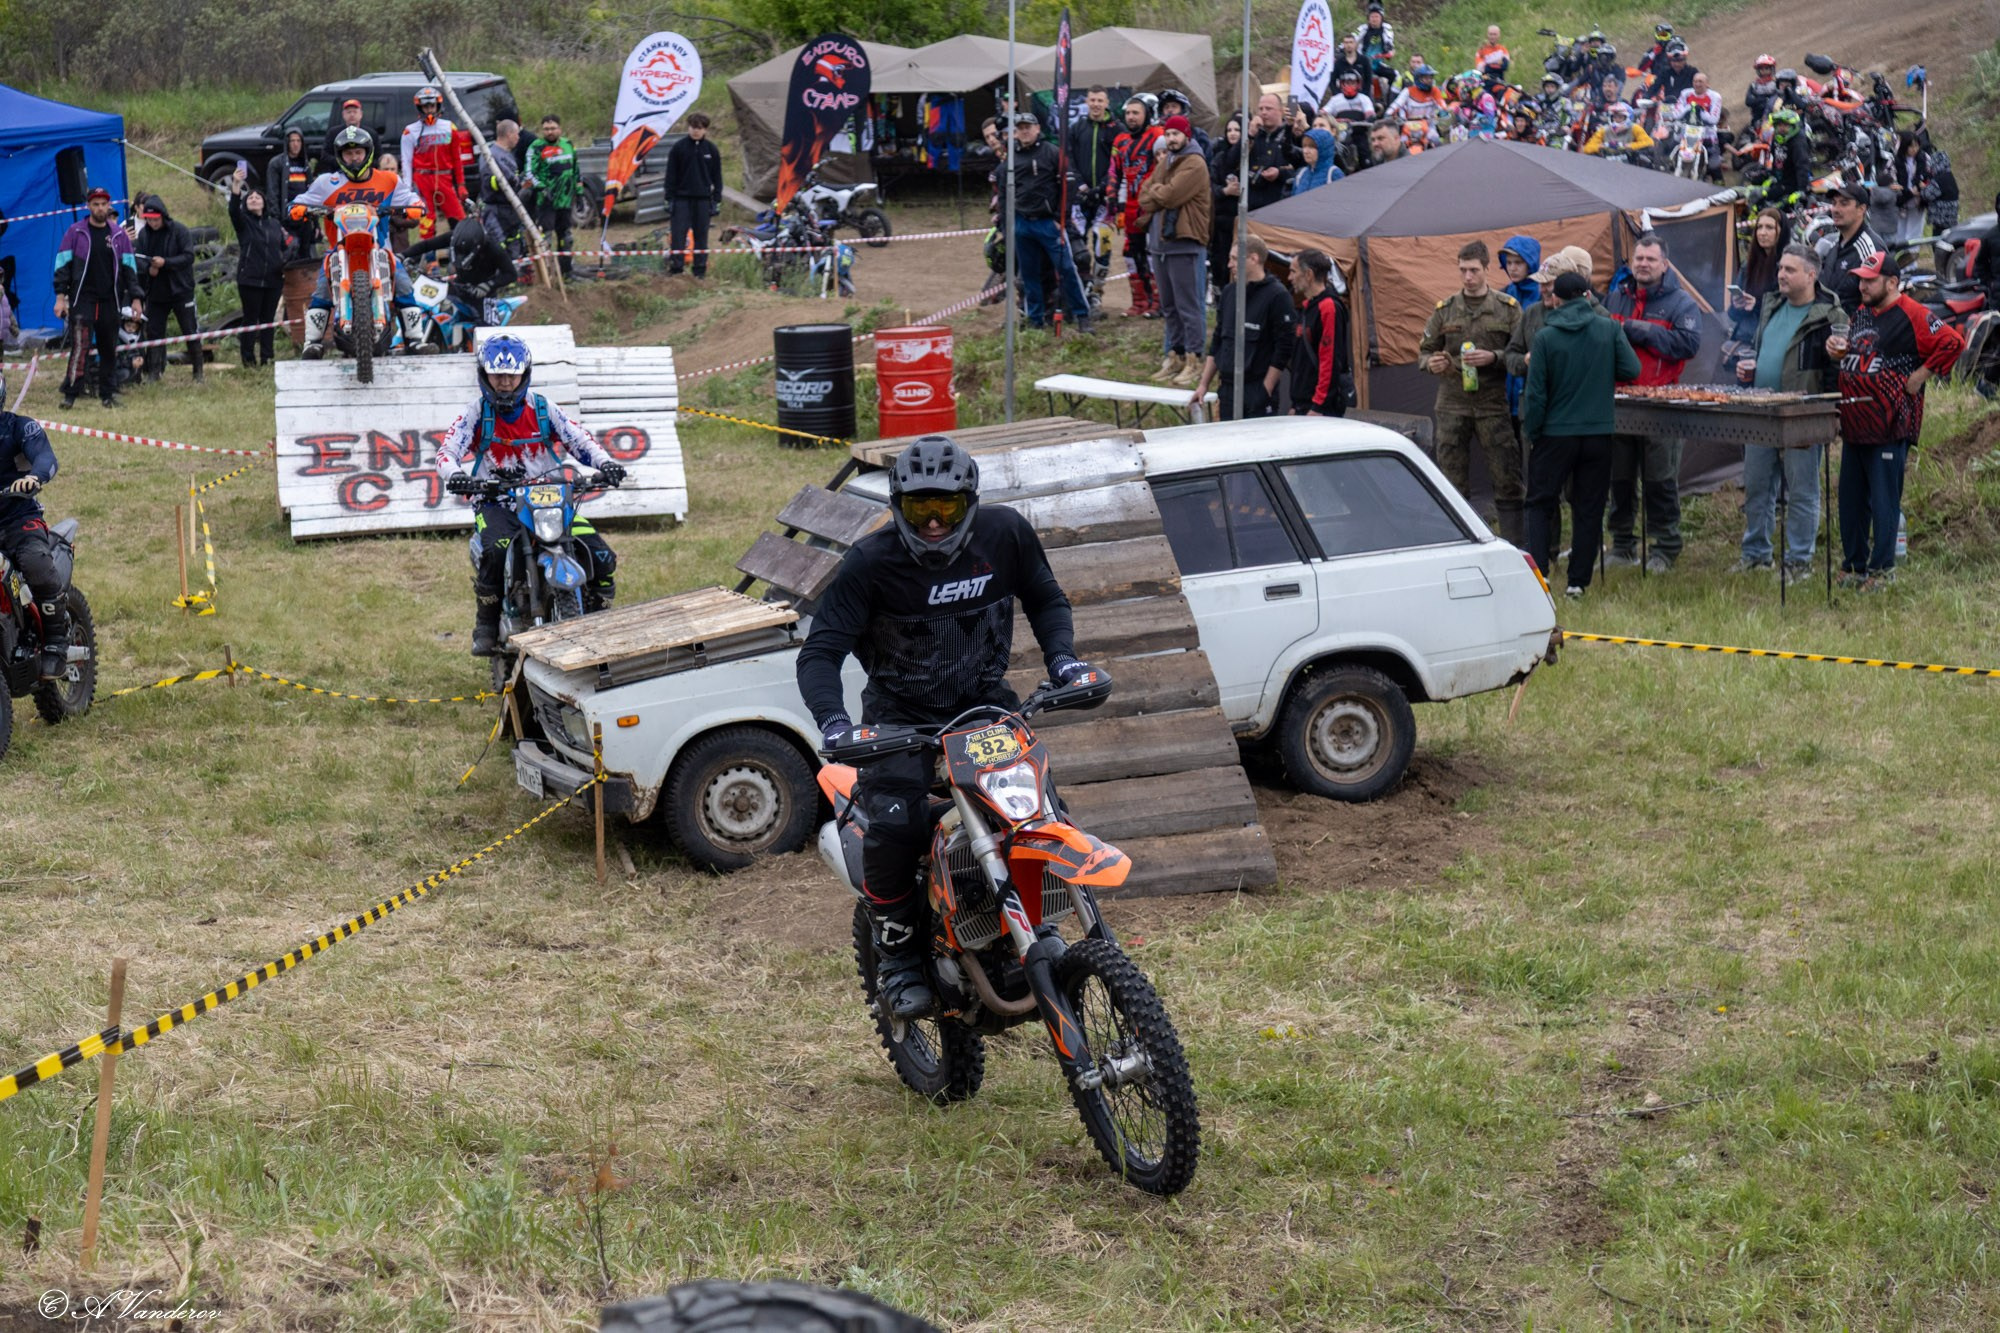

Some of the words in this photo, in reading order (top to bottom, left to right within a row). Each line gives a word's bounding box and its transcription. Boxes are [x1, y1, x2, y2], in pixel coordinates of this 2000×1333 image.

[638, 41, 670, 62] СТАНКИ
[672, 43, 688, 57] ЧПУ
[802, 41, 866, 68] ENDURO
[629, 70, 694, 83] HYPERCUT
[336, 188, 385, 205] KTM
[776, 381, 834, 394] ECORD
[538, 493, 552, 502] 71
[928, 573, 993, 606] LEATT
[971, 734, 986, 743] HILL
[980, 738, 1008, 756] 82
[988, 752, 1012, 764] HOBBY
